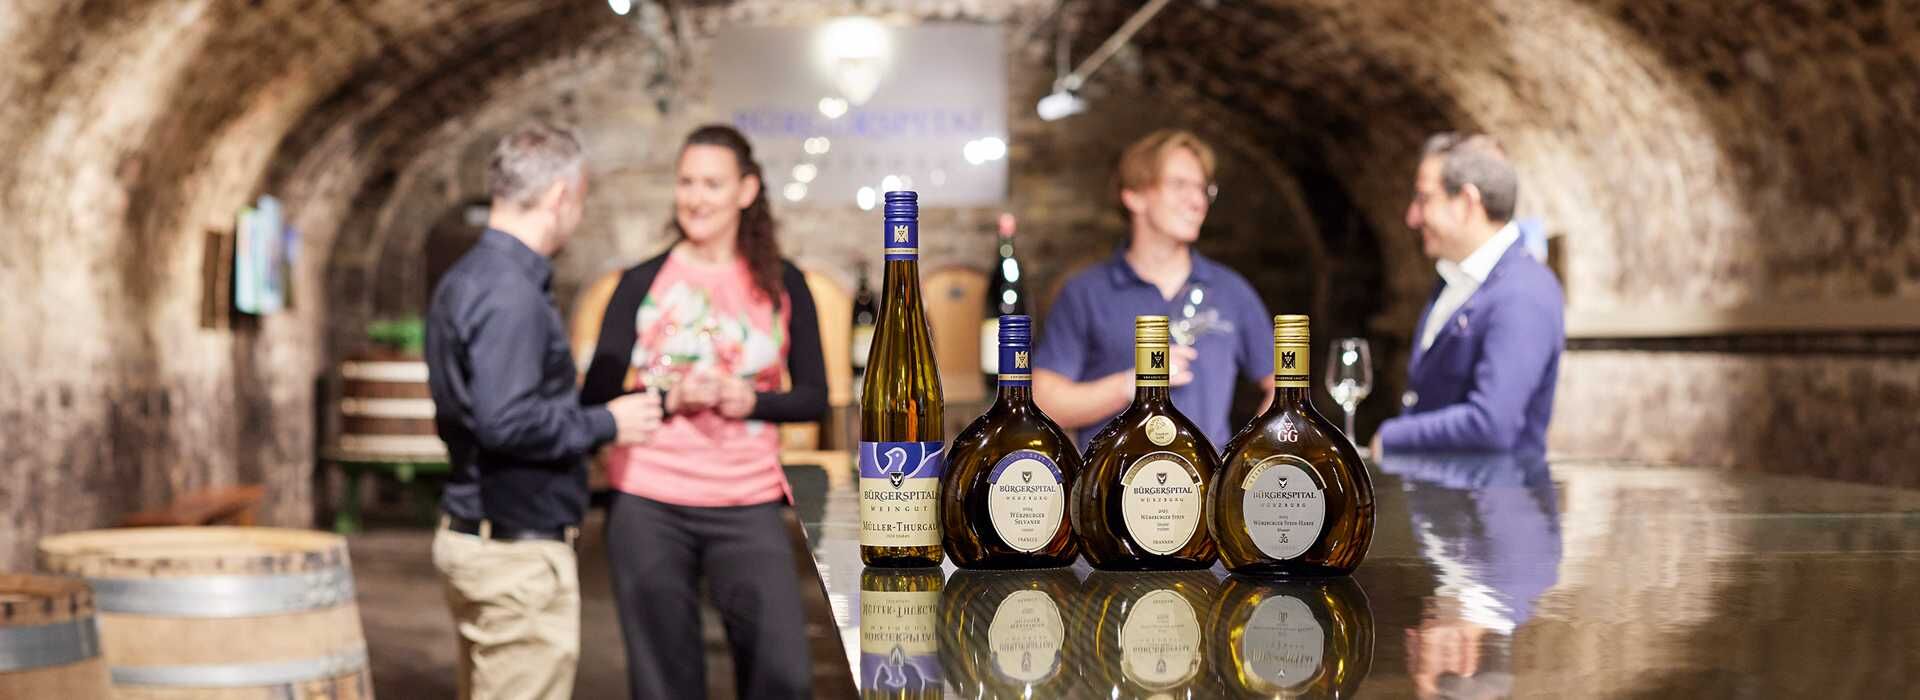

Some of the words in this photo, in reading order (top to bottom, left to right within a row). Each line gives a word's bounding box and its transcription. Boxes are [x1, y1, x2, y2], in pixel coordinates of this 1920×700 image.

[1278, 430, 1298, 443] GG
[1000, 485, 1056, 494] BÜRGERSPITAL
[1133, 486, 1193, 496] BÜRGERSPITAL
[1253, 490, 1317, 499] BÜRGERSPITAL
[864, 489, 937, 503] BÜRGERSPITAL
